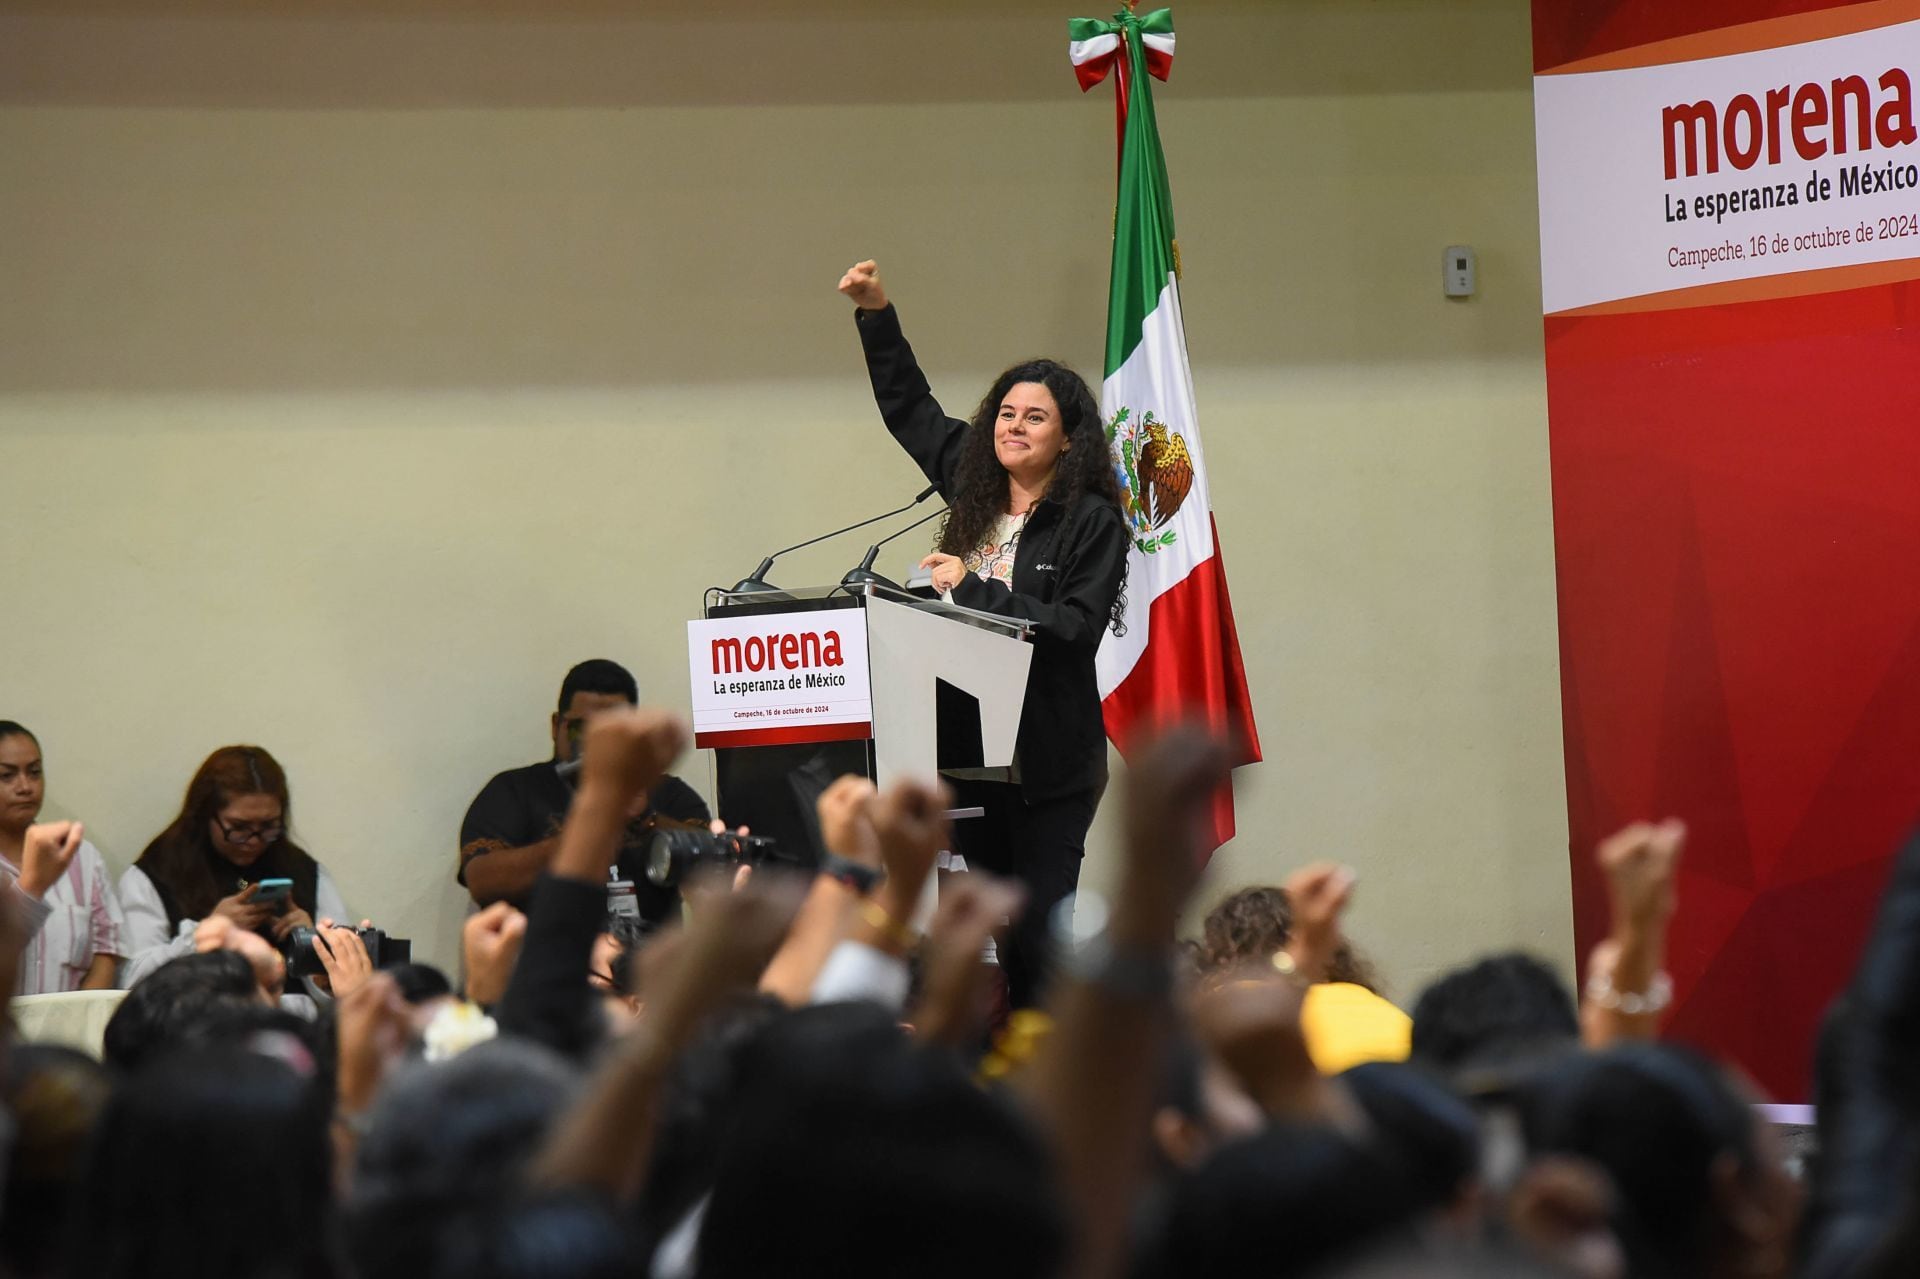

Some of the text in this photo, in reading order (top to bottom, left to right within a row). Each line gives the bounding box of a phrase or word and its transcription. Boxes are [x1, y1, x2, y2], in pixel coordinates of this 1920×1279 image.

[1662, 67, 1918, 180] morena
[1665, 160, 1918, 224] La esperanza de México
[1667, 213, 1919, 269] Campeche, 16 de octubre de 2024
[711, 630, 844, 674] morena
[713, 672, 846, 697] La esperanza de México
[733, 710, 765, 719] Campeche,
[773, 708, 781, 716] de
[782, 707, 804, 716] octubre
[806, 706, 813, 714] de
[814, 705, 829, 713] 2024
